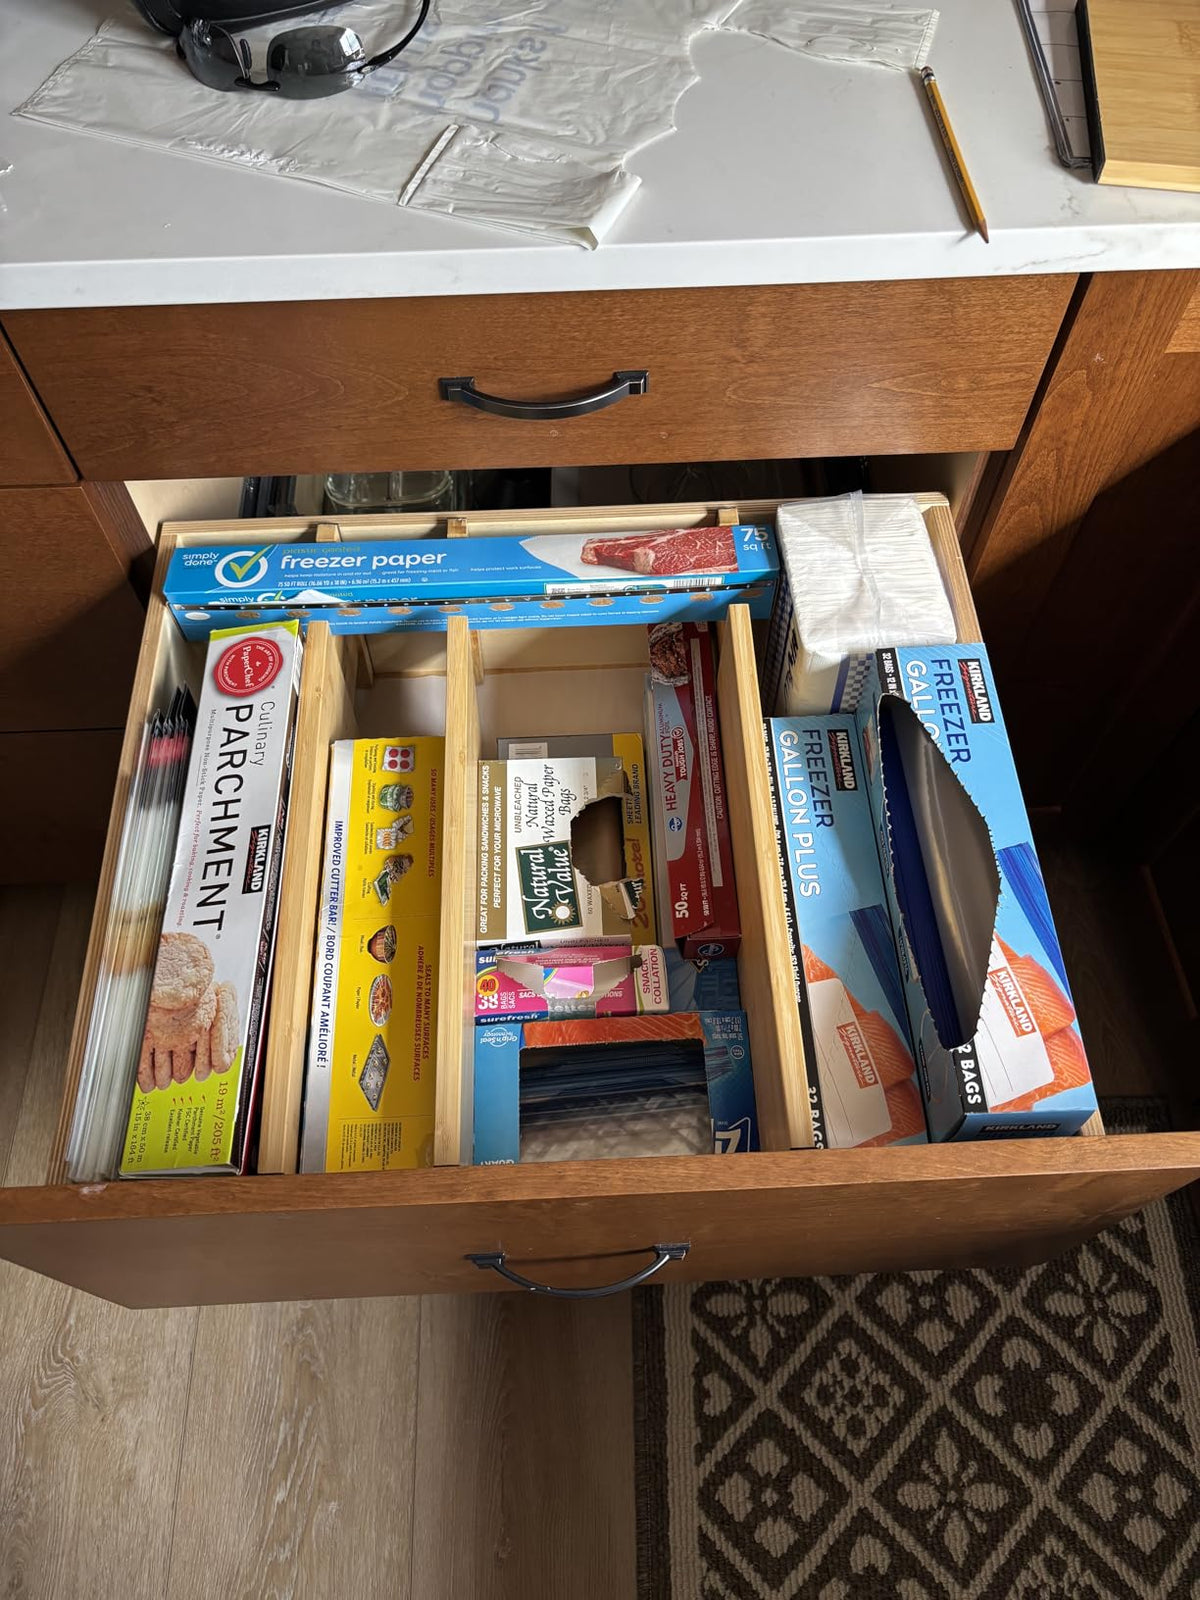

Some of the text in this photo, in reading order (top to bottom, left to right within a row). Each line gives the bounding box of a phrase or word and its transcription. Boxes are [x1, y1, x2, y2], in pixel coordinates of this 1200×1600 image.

[741, 528, 770, 542] 75
[744, 541, 773, 557] sq ft
[182, 552, 219, 563] simply
[281, 555, 367, 569] freezer
[372, 551, 447, 570] paper
[219, 596, 255, 605] simply
[241, 645, 255, 688] PaperChef
[883, 660, 895, 673] BAGS
[906, 660, 942, 747] GALLO
[967, 662, 992, 722] KIRKLAND
[931, 659, 971, 763] FREEZER
[250, 701, 276, 766] Culinary
[660, 734, 673, 768] DUTY
[430, 768, 438, 776] SO
[679, 755, 687, 777] TOUGH
[711, 757, 720, 772] EDGE
[780, 730, 812, 824] GALLON
[837, 732, 856, 790] KIRKLAND
[429, 778, 437, 795] MANY
[481, 765, 490, 795] SNACKS
[631, 764, 642, 824] LEADING BRAND
[663, 771, 677, 811] HEAVY
[712, 772, 722, 794] CUTTING
[803, 730, 835, 828] FREEZER
[428, 797, 437, 812] USES
[513, 776, 522, 833] UNBLEACHED
[522, 783, 540, 828] Natural
[540, 764, 560, 842] Waxed Paper
[558, 788, 576, 816] Bags
[332, 821, 344, 866] IMPROVED
[428, 818, 436, 840] USAGES
[481, 802, 490, 851] SANDWICHES
[250, 828, 269, 890] KIRKLAND
[427, 842, 436, 877] MULTIPLES
[493, 786, 502, 908] PERFECT FOR YOUR MICROWAVE
[480, 852, 489, 887] PACKING
[545, 848, 574, 904] Value
[793, 833, 821, 897] PLUS
[329, 868, 341, 902] CUTTER
[480, 889, 489, 905] FOR
[520, 848, 551, 919] Natural
[674, 883, 689, 919] 50 SQ FT
[328, 905, 339, 926] BAR!
[480, 906, 489, 933] GREAT
[325, 935, 336, 960] BORD
[321, 963, 333, 1008] COUPANT
[415, 981, 424, 990] DE
[424, 986, 432, 996] TO
[480, 980, 496, 992] 40
[650, 949, 662, 1005] COLLATION
[414, 992, 424, 1042] NOMBREUSES
[423, 998, 431, 1020] MANY
[508, 991, 516, 1009] SACS
[997, 971, 1034, 1032] KIRKLAND
[480, 1013, 539, 1024] surefresh
[317, 1011, 331, 1062] AMÉLIORÉ
[422, 1022, 431, 1060] SURFACES
[413, 1043, 422, 1081] SURFACES
[845, 1025, 876, 1084] KIRKLAND
[218, 1081, 229, 1094] 19
[958, 1042, 982, 1105] 2 BAGS
[141, 1122, 149, 1134] cm
[984, 1124, 1057, 1132] KIRKLAND
